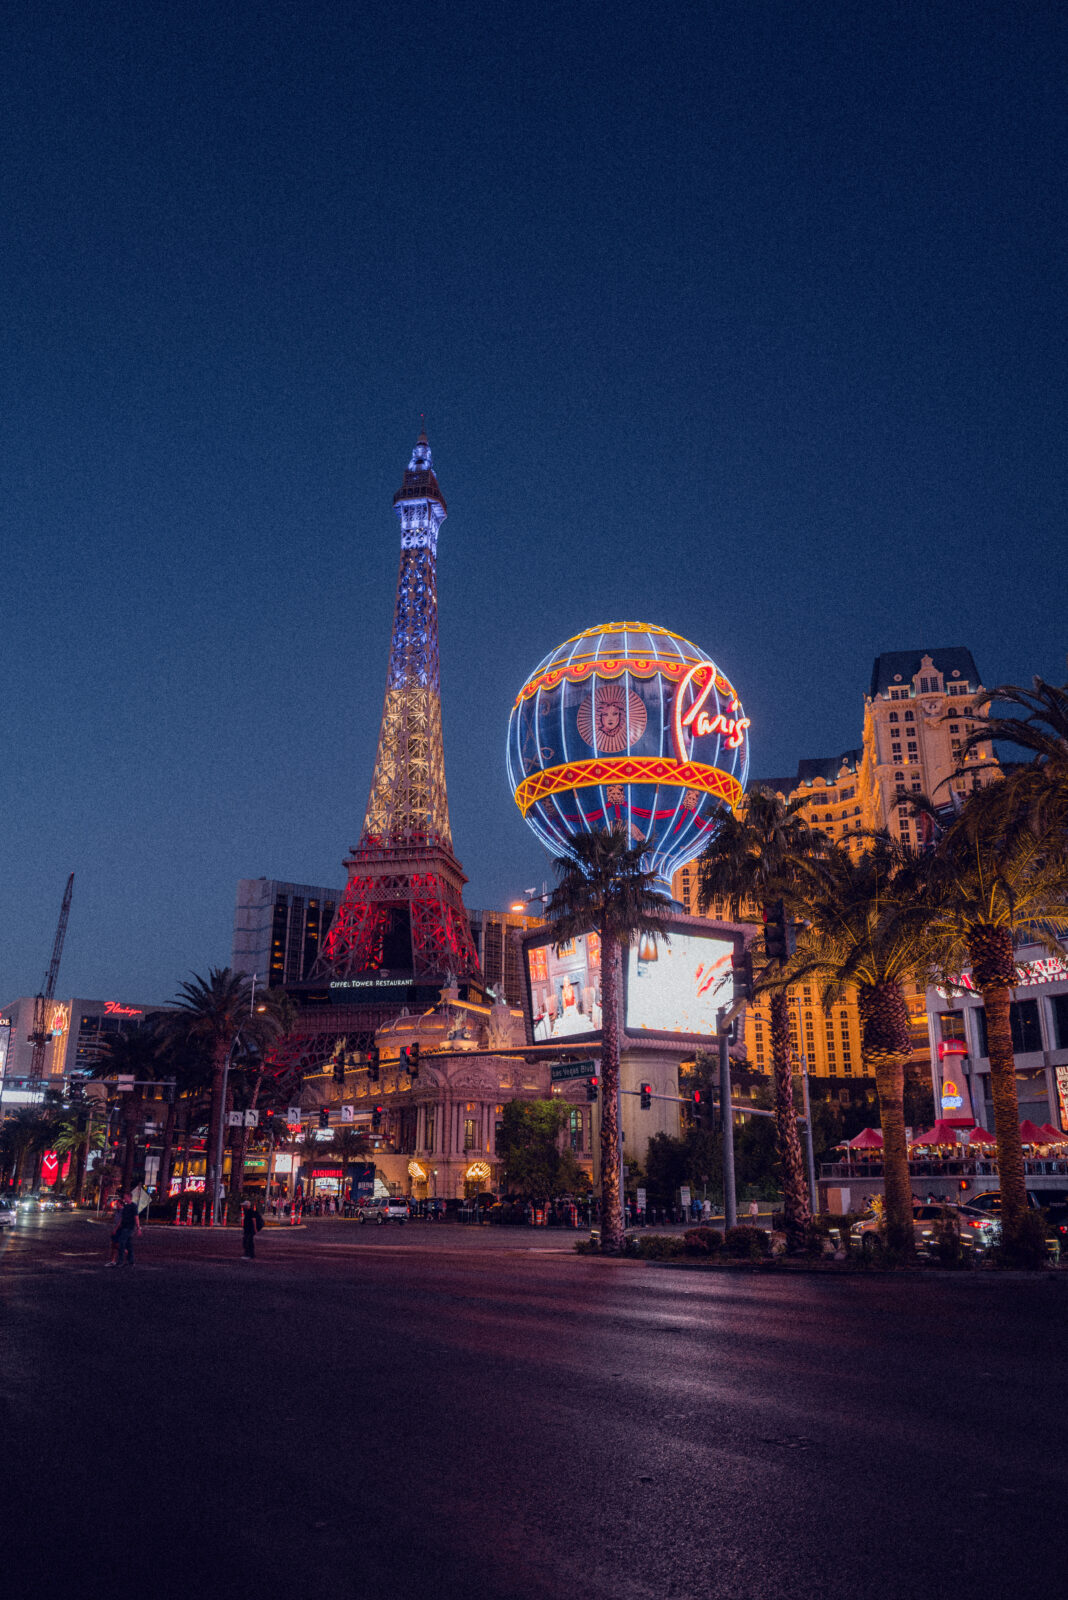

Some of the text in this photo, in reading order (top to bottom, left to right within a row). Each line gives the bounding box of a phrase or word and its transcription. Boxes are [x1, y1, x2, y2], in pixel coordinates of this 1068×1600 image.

[675, 660, 752, 764] Paris
[104, 1001, 142, 1017] Flamingo
[580, 1065, 593, 1073] Blvd
